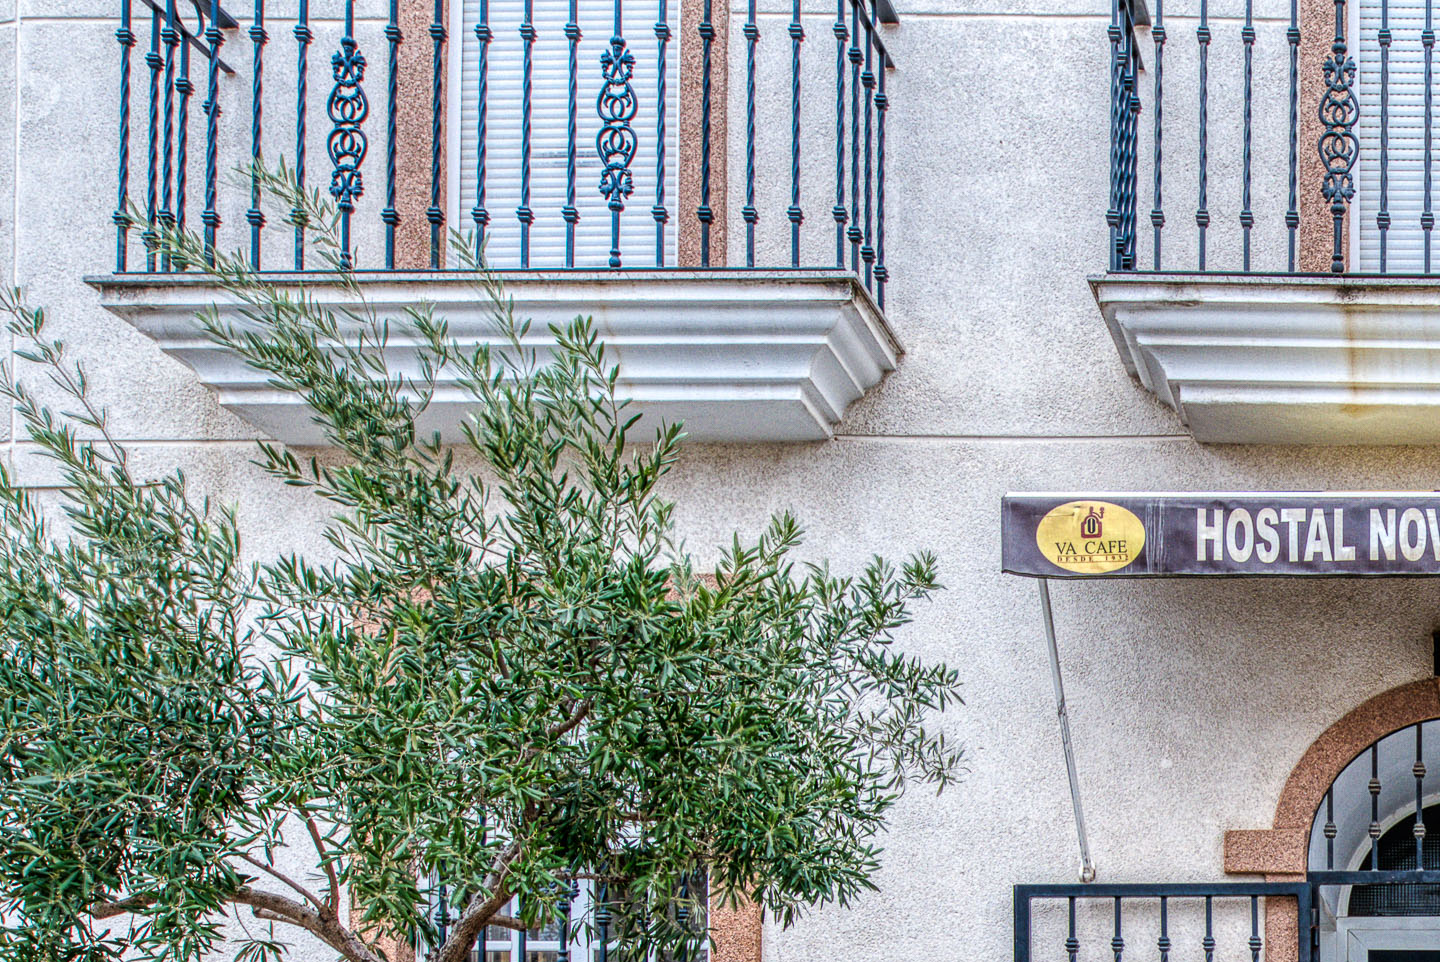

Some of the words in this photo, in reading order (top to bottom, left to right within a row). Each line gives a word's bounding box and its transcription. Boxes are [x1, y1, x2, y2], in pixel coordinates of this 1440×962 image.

[1196, 507, 1356, 563] HOSTAL
[1055, 541, 1077, 555] VA
[1084, 540, 1128, 554] CAFE
[1057, 555, 1094, 563] DESDE
